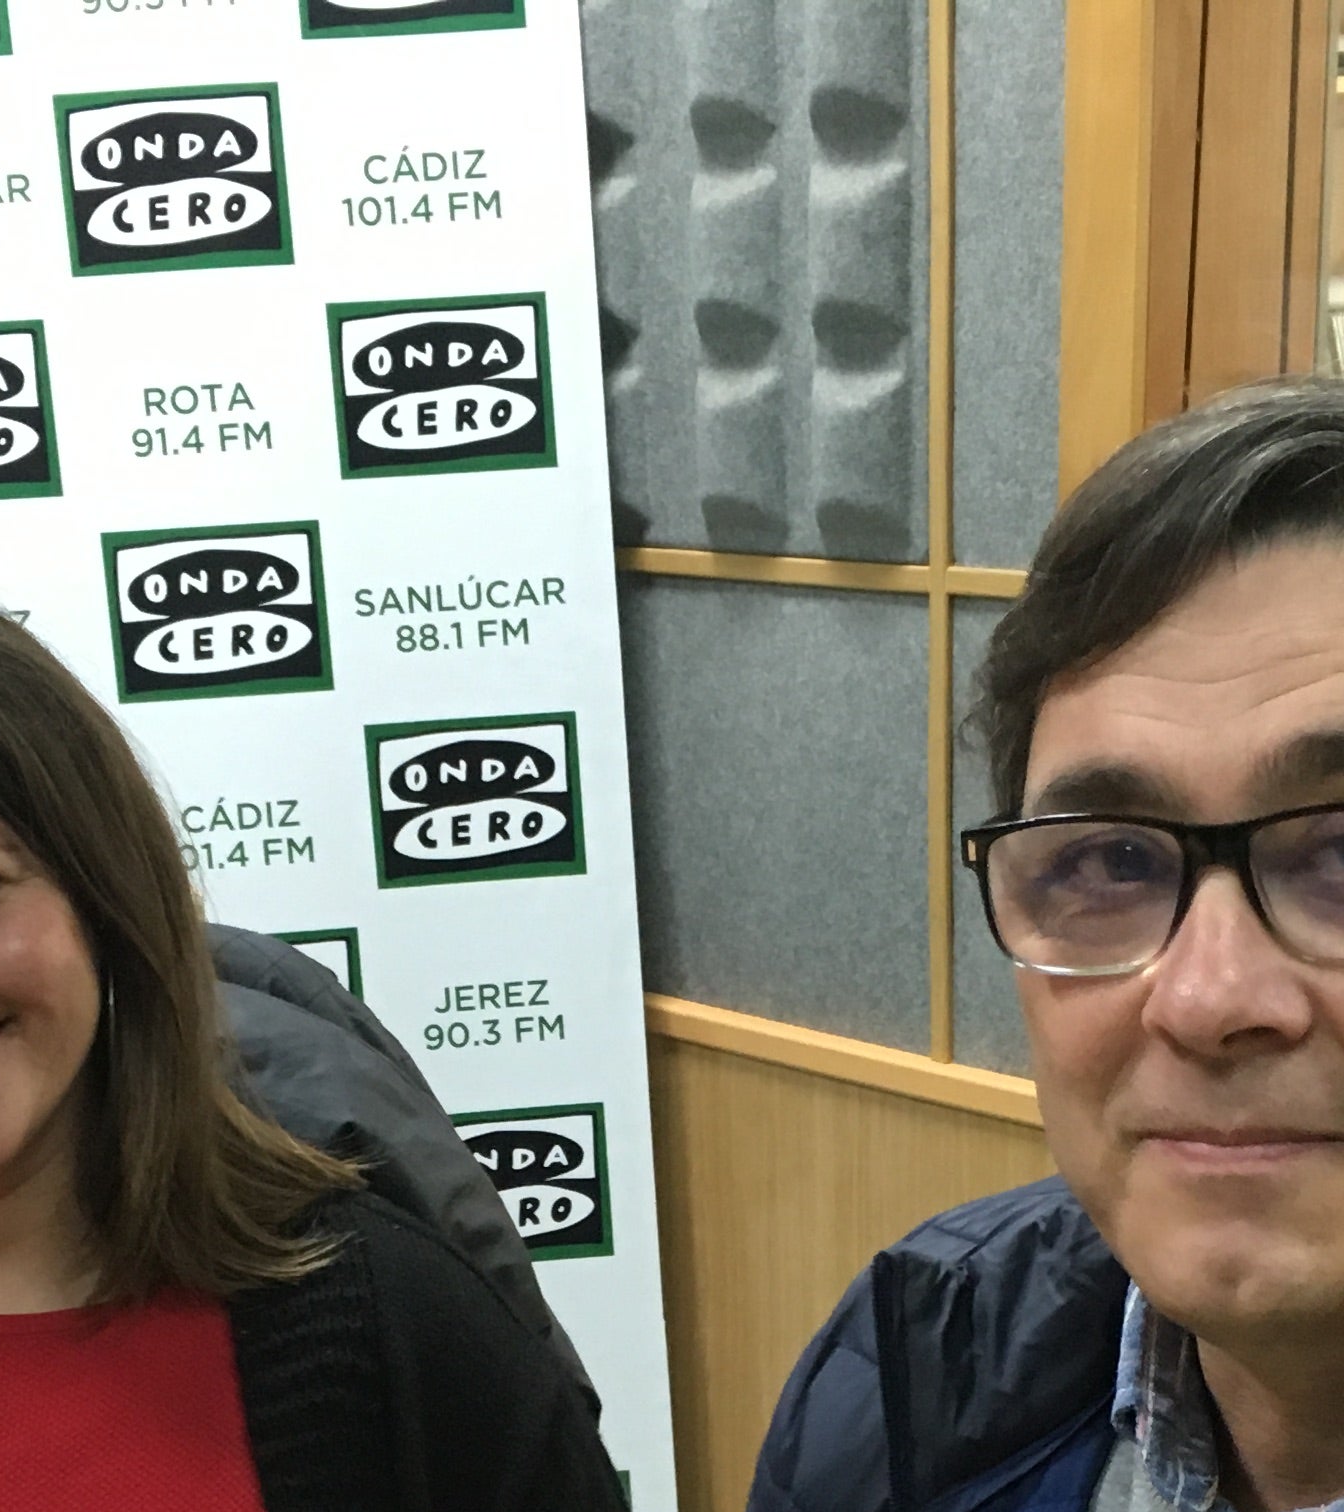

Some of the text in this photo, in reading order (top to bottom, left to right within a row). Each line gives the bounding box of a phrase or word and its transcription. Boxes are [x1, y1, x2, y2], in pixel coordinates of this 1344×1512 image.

[96, 129, 242, 170] ONDA
[363, 145, 487, 185] CÁDIZ
[112, 191, 247, 234] CERO
[341, 189, 502, 227] 101.4 FM
[368, 338, 509, 377] ONDA
[143, 382, 256, 417] ROTA
[381, 398, 513, 438] CERO
[131, 420, 273, 458] 91.4 FM
[143, 566, 284, 603] ONDA
[354, 574, 566, 617] SANLÚCAR
[158, 624, 289, 663] CERO
[395, 617, 530, 653] 88.1 FM
[404, 755, 540, 792] ONDA
[182, 797, 300, 833] CÁDIZ
[416, 810, 544, 849] CERO
[179, 835, 315, 871] 01.4 FM
[434, 979, 550, 1014] JEREZ
[423, 1014, 565, 1051] 90.3 FM
[473, 1145, 569, 1170] NDA
[519, 1197, 572, 1227] RO
